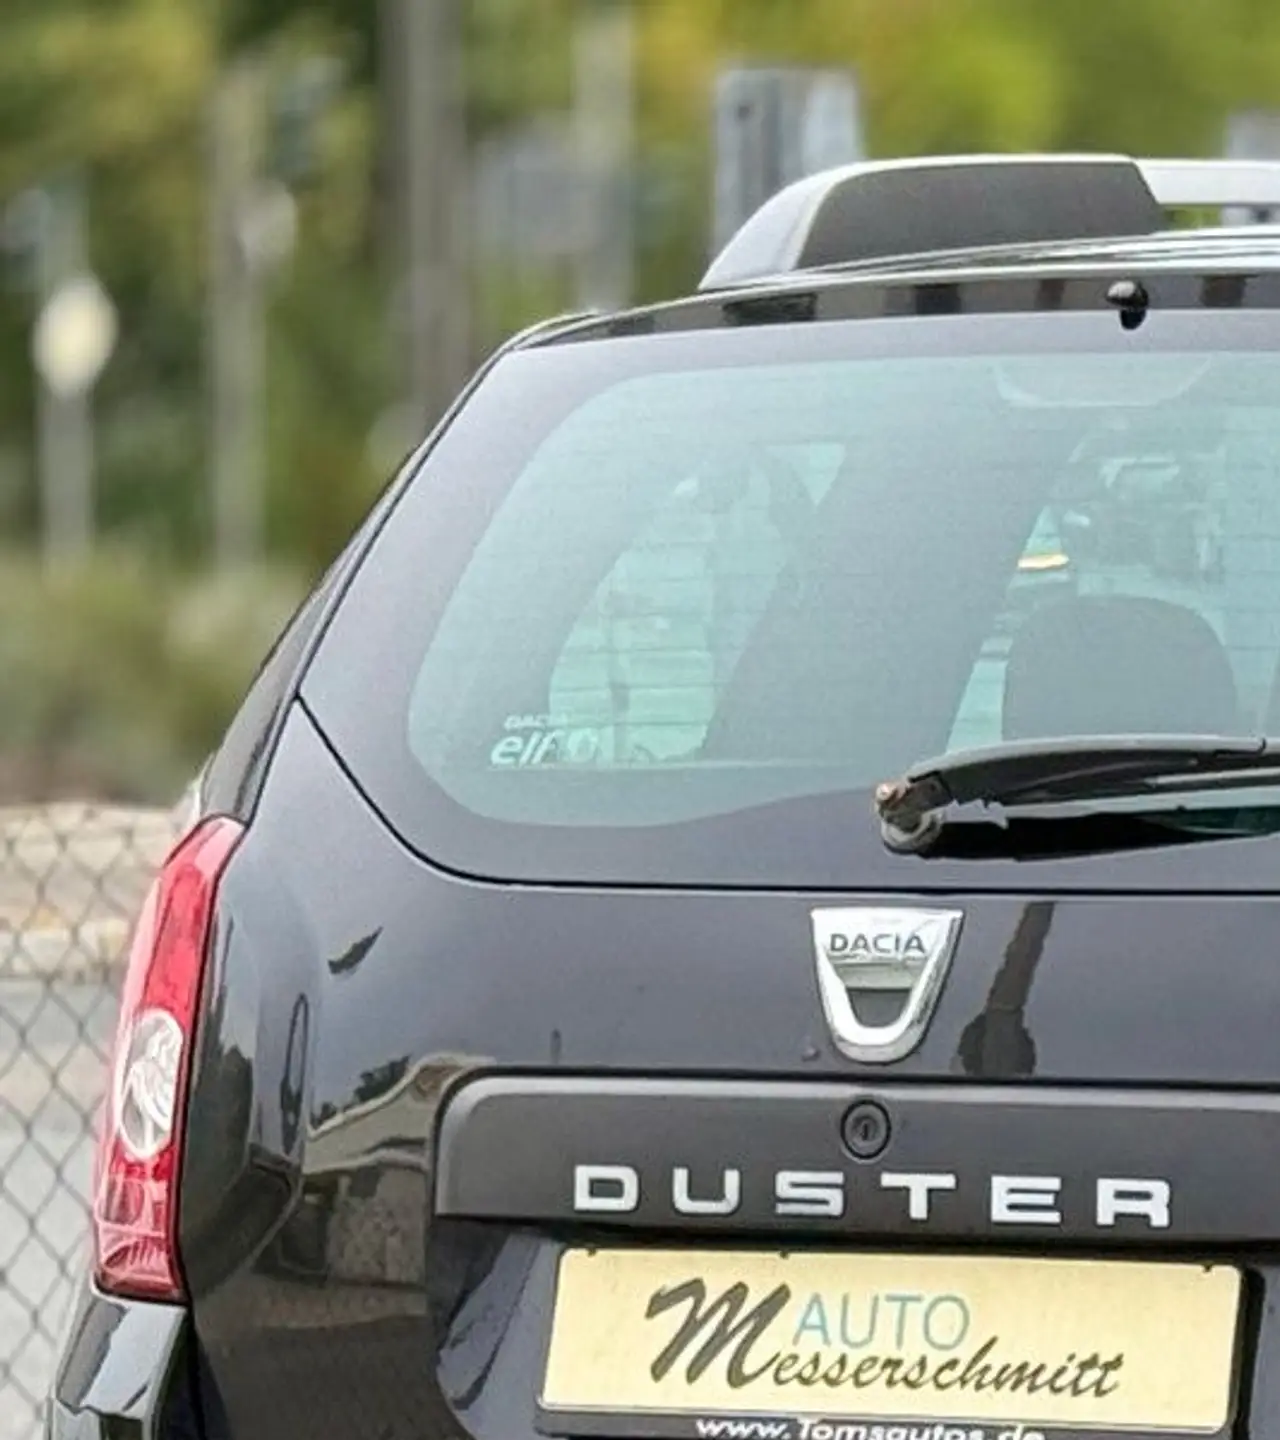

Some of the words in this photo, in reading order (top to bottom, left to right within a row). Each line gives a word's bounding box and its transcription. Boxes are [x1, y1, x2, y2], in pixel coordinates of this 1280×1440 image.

[830, 933, 926, 954] DACIA
[572, 1164, 1173, 1228] DUSTER
[645, 1277, 1125, 1397] Messerschmitt
[793, 1293, 971, 1351] AUTO
